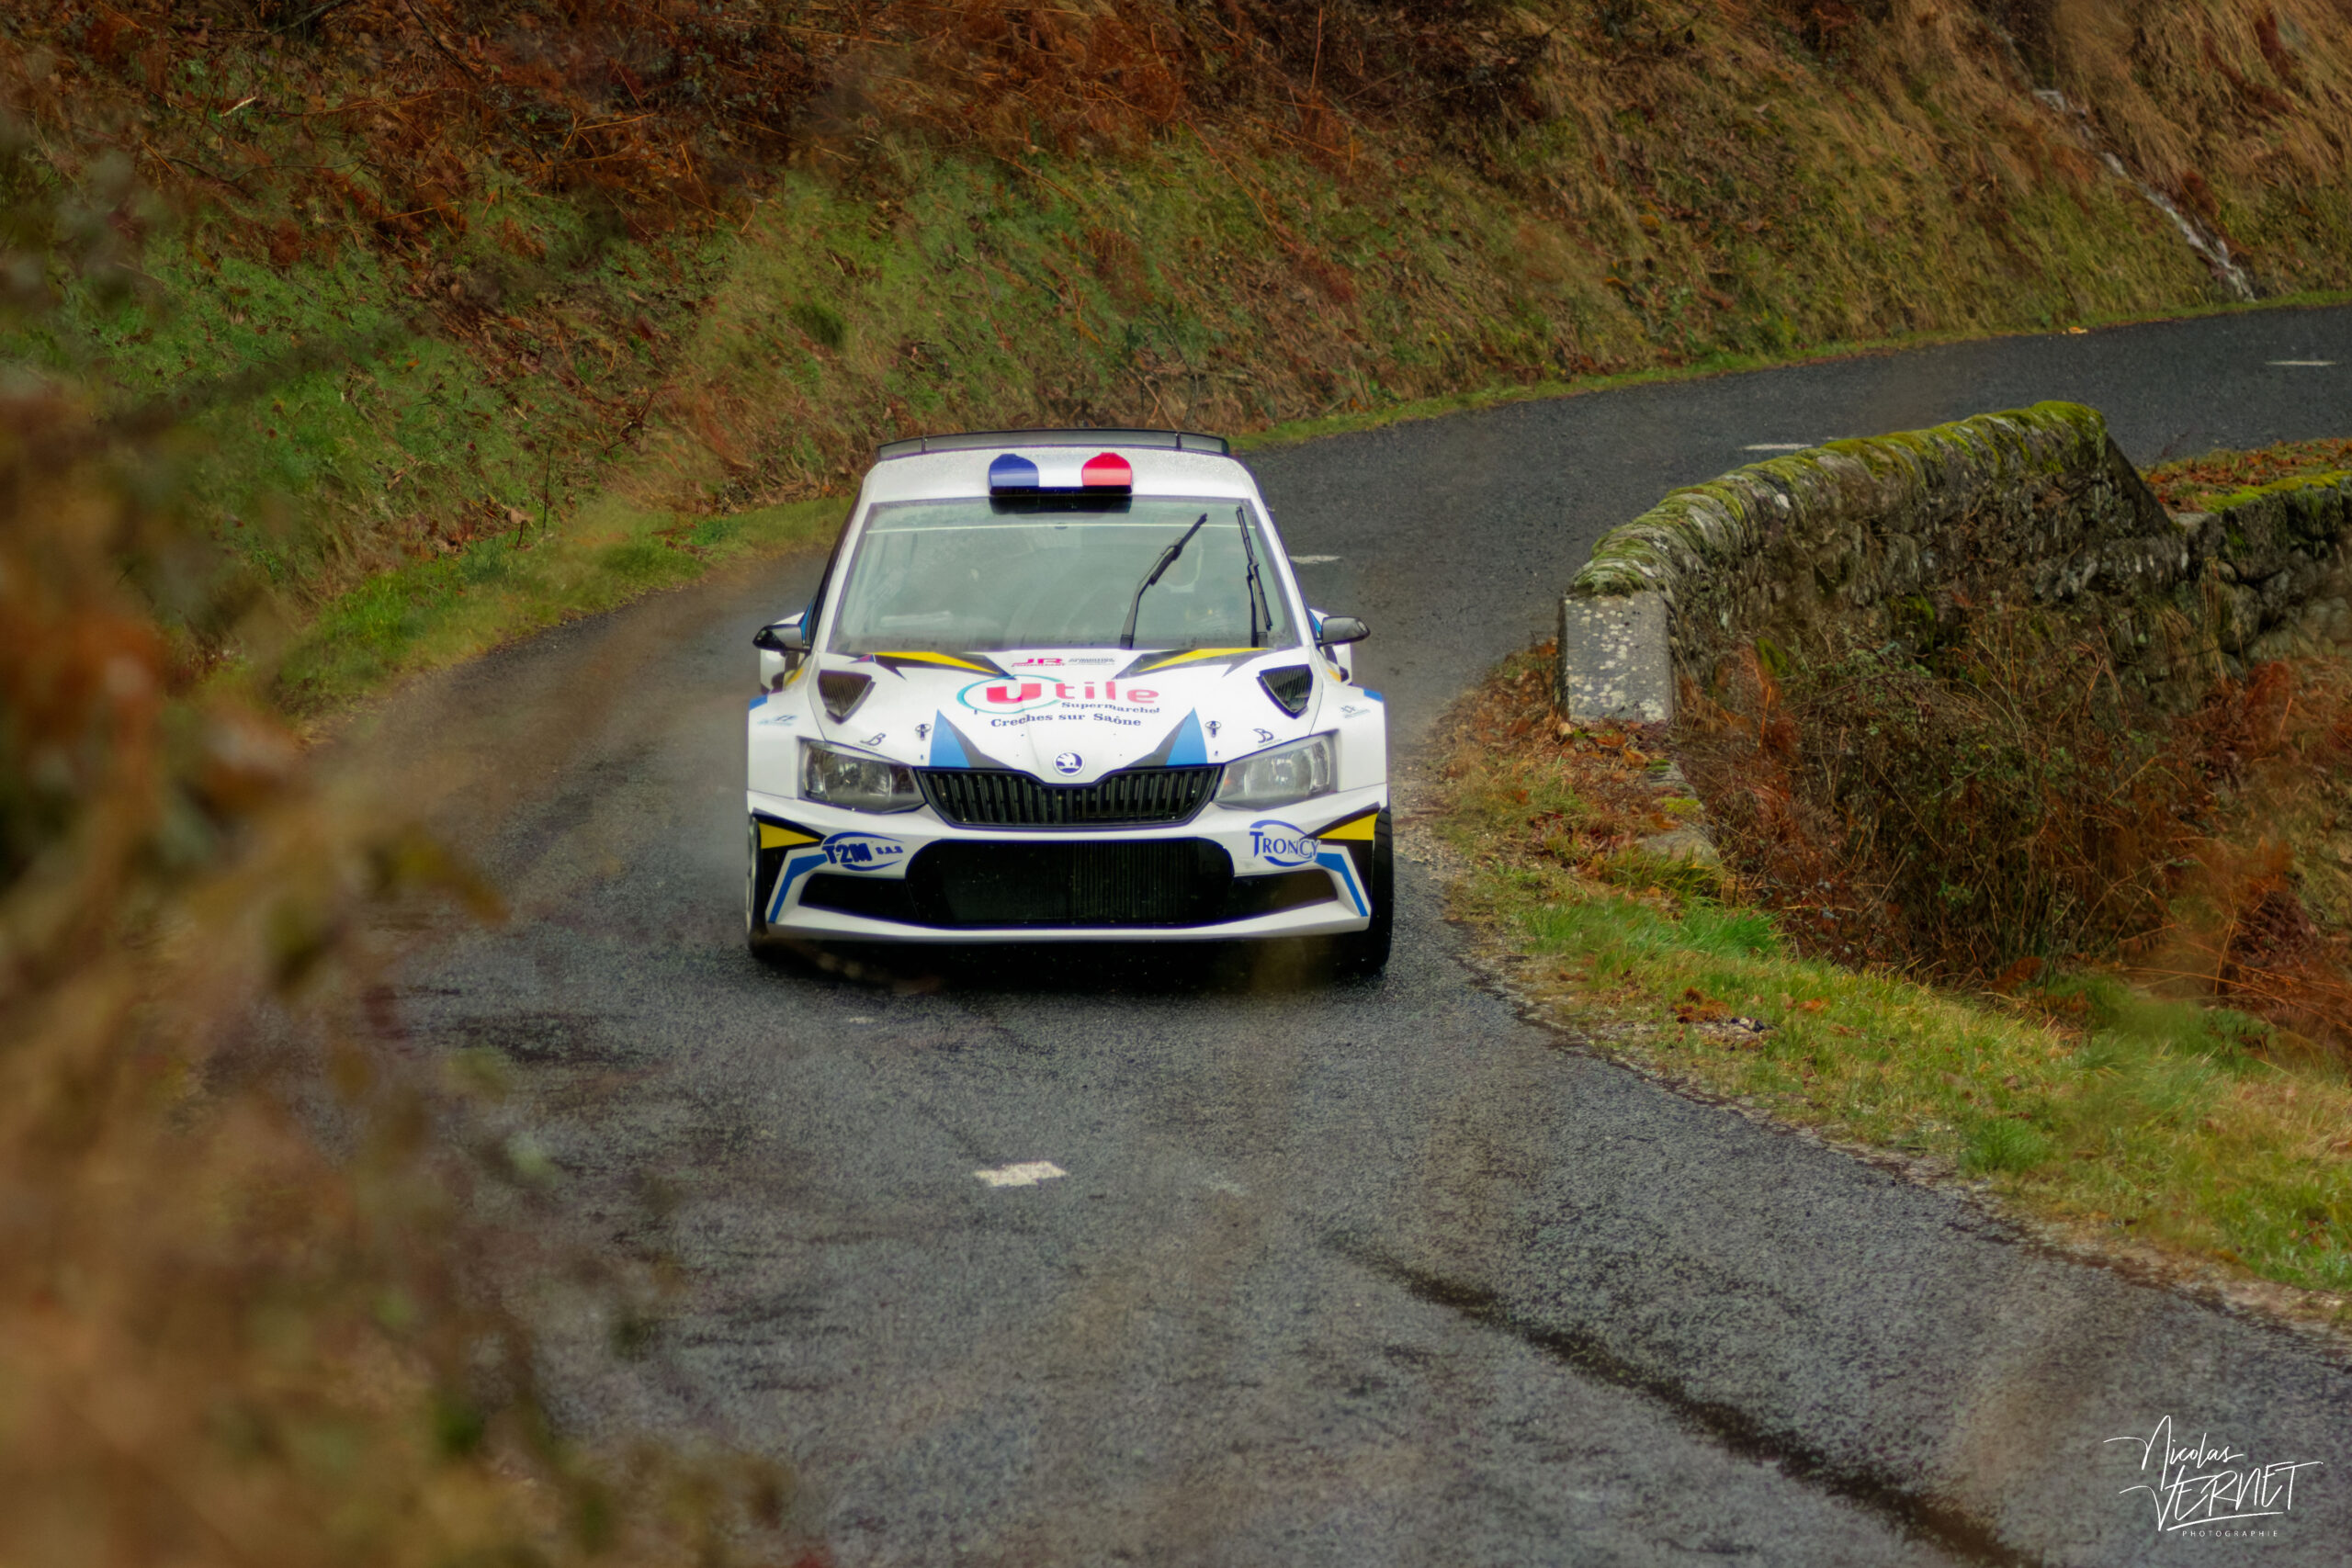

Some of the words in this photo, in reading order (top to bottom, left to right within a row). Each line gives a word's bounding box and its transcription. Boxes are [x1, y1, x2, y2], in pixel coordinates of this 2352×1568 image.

[986, 681, 1159, 705] Utile
[1093, 713, 1141, 727] Saône
[1249, 830, 1321, 859] TRONCY
